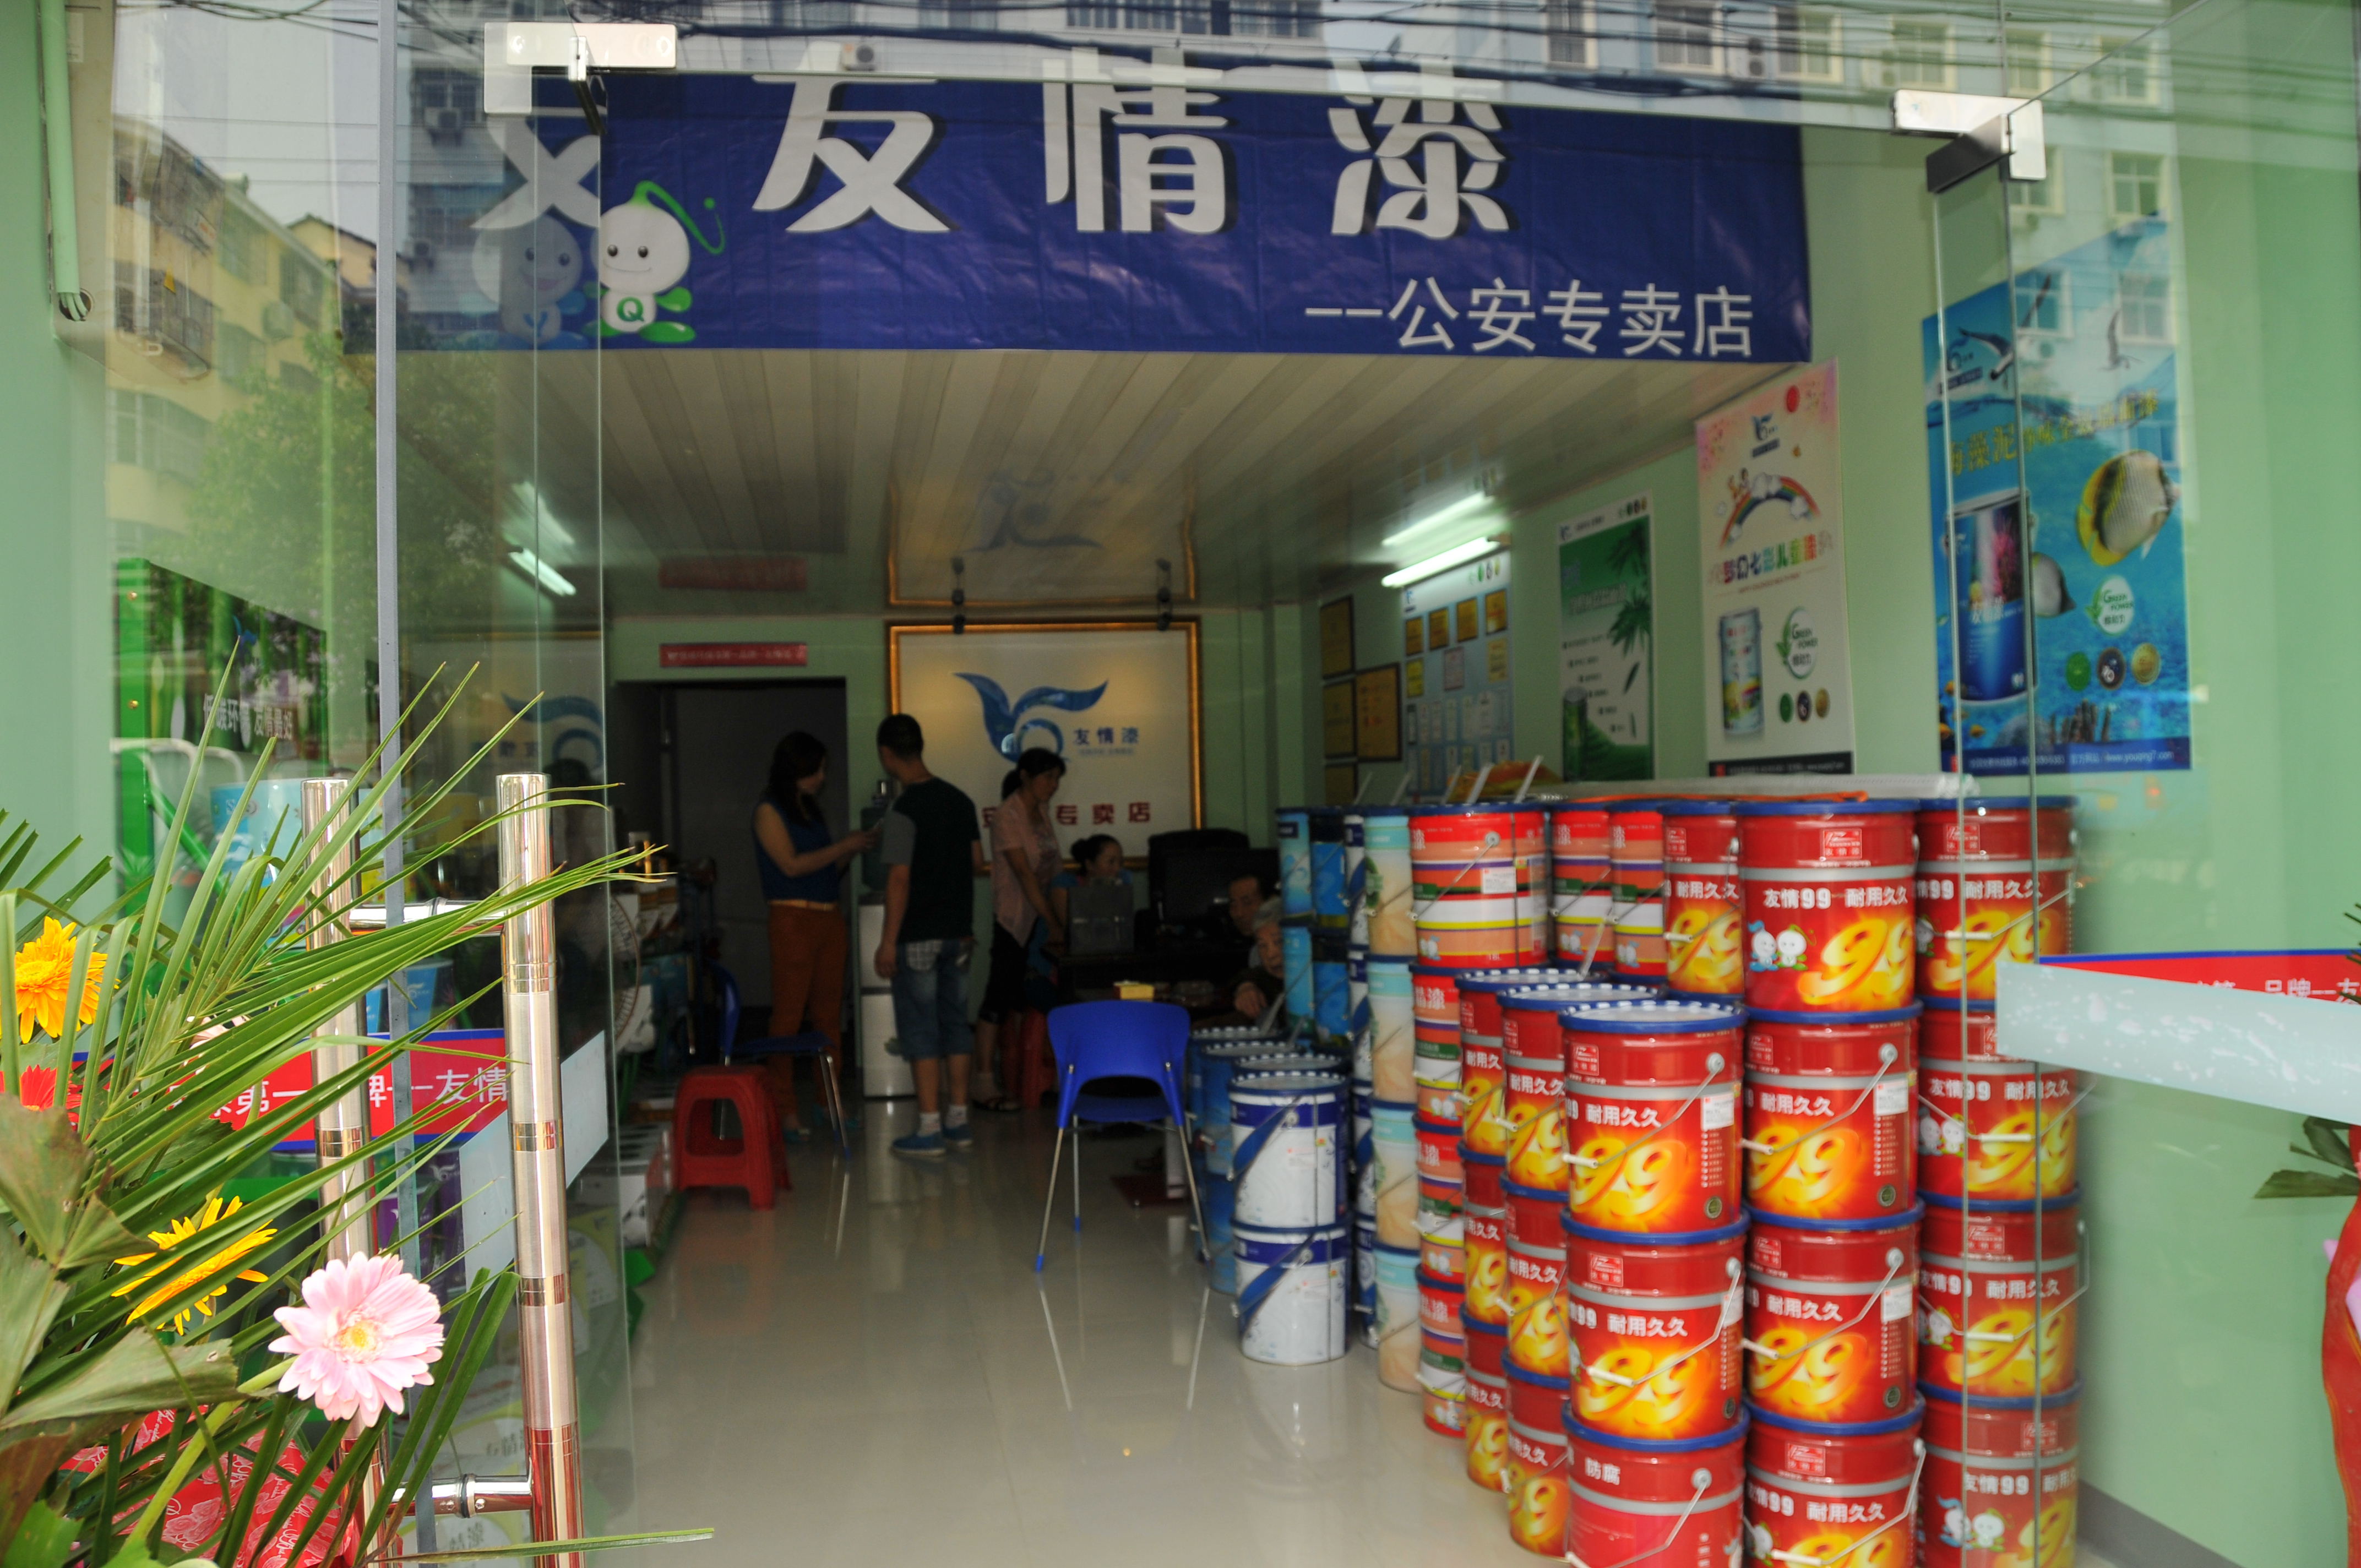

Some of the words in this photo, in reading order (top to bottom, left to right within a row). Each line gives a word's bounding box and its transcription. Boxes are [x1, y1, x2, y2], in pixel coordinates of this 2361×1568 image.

[616, 297, 645, 322] Q
[1763, 887, 1831, 909] 友情99
[1844, 885, 1908, 908] 耐用久久
[1586, 1103, 1662, 1128] 耐用久久
[1760, 1092, 1835, 1117] 耐用久久
[1766, 1294, 1843, 1322] 耐用久久
[1608, 1314, 1688, 1338] 耐用久久
[1585, 1456, 1620, 1485] 防腐
[1807, 1501, 1885, 1523] 耐用久久
